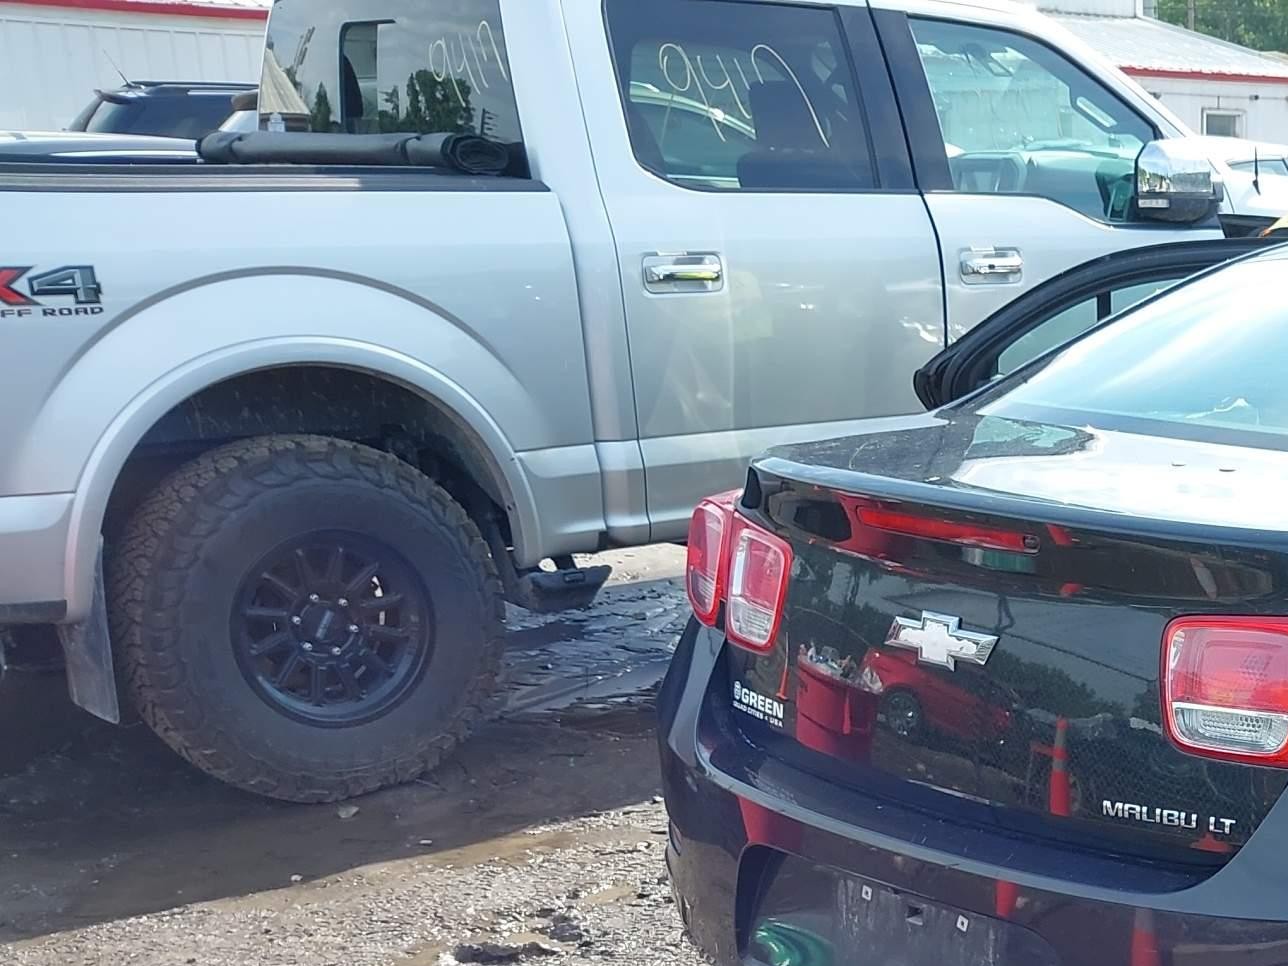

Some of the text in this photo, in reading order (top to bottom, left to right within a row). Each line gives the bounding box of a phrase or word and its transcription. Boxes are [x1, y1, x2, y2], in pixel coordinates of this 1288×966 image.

[660, 43, 830, 148] 9417
[42, 306, 104, 317] ROAD
[741, 687, 784, 720] GREEN
[1102, 799, 1237, 835] MALIBU LT
